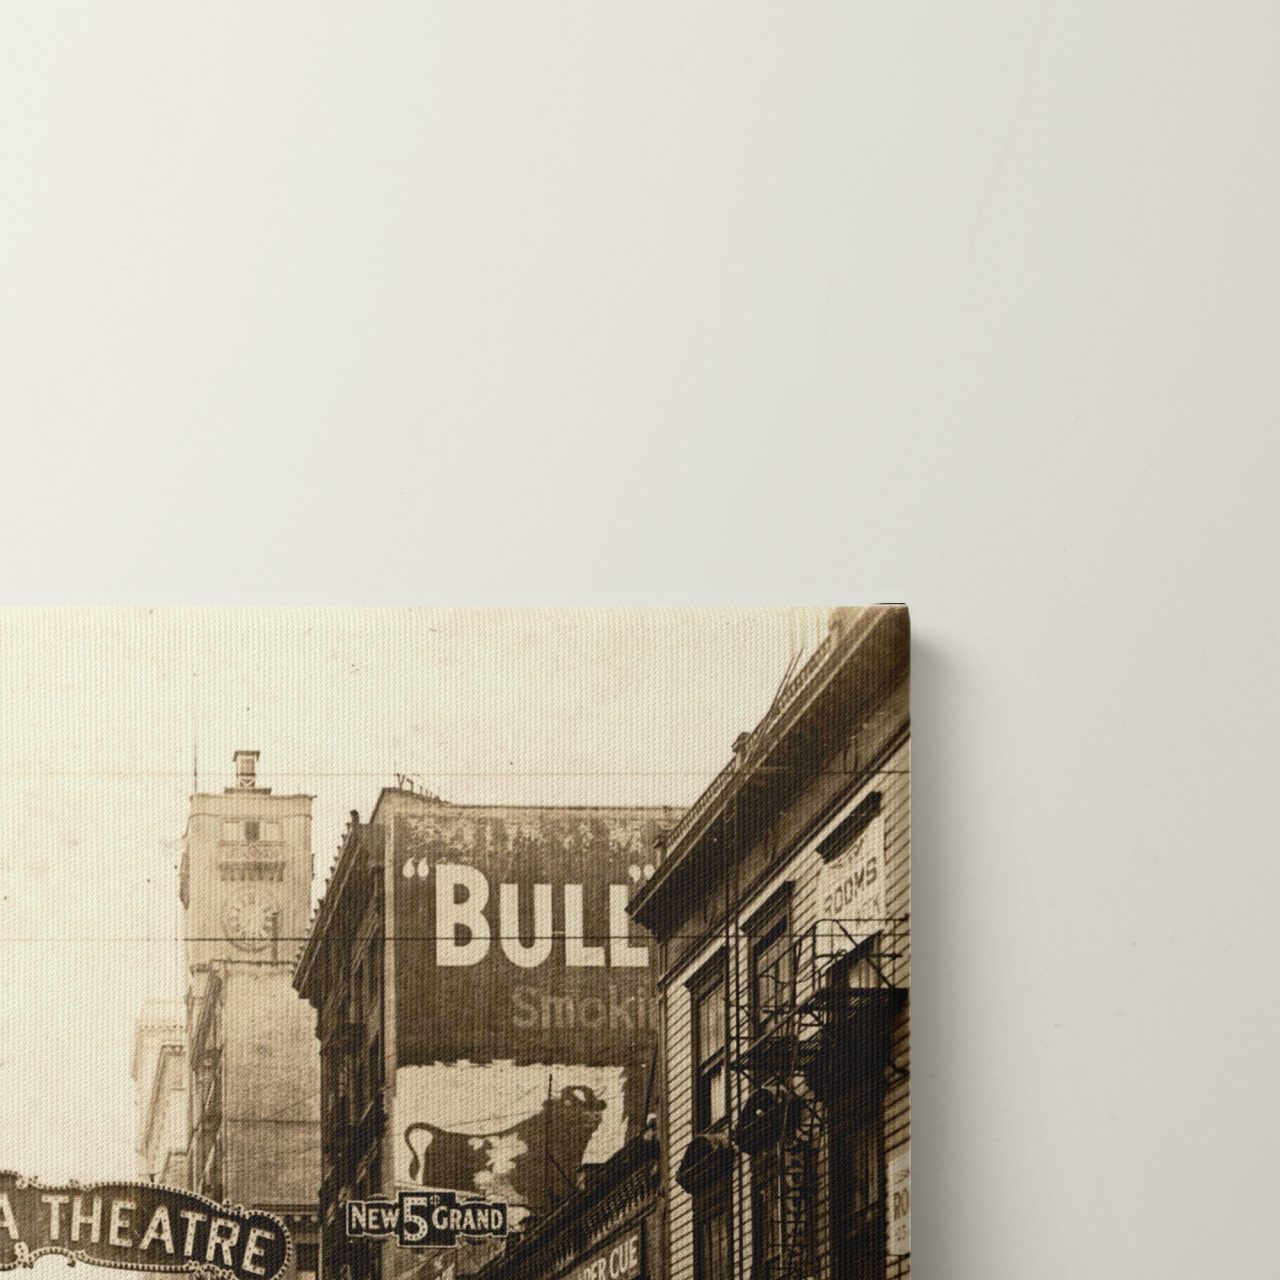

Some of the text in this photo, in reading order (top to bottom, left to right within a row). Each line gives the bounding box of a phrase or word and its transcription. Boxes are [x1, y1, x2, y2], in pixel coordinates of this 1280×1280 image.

[42, 1194, 277, 1276] THEATRE
[351, 1204, 401, 1230] NEW
[431, 1206, 504, 1231] GRAND
[609, 1235, 639, 1279] CUE
